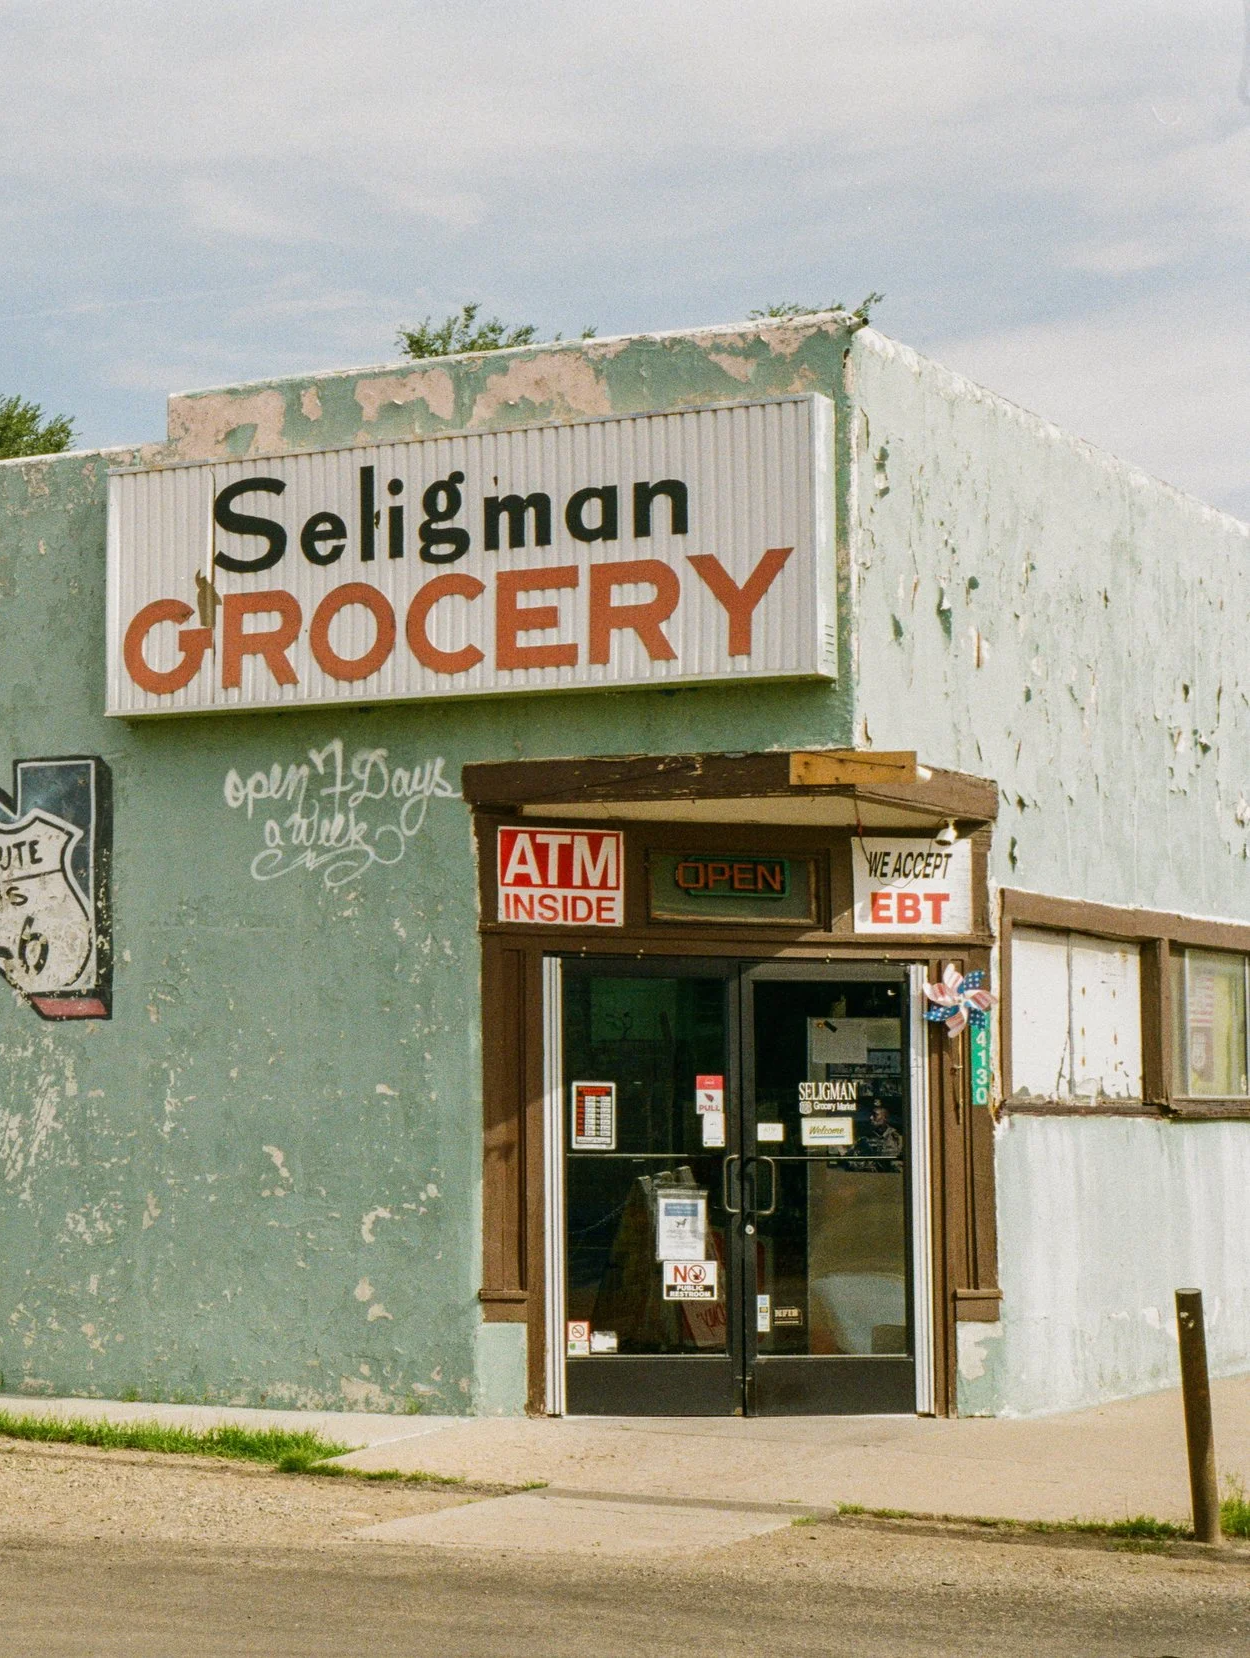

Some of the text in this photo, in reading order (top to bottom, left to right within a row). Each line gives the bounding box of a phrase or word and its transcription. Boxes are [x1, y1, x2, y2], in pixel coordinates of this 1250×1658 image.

[213, 465, 689, 574] Seligman
[123, 546, 794, 695] GROCERY
[348, 749, 463, 836] Days
[503, 832, 618, 888] ATM
[869, 851, 953, 879] WE ACCEPT
[676, 862, 782, 892] OPEN
[504, 893, 617, 924] INSIDE
[870, 892, 950, 925] EBT
[798, 1082, 858, 1101] SELIGMAN
[813, 1101, 836, 1112] Grocery
[836, 1102, 857, 1111] Market
[698, 1104, 721, 1112] PULL
[809, 1125, 845, 1135] Welcome
